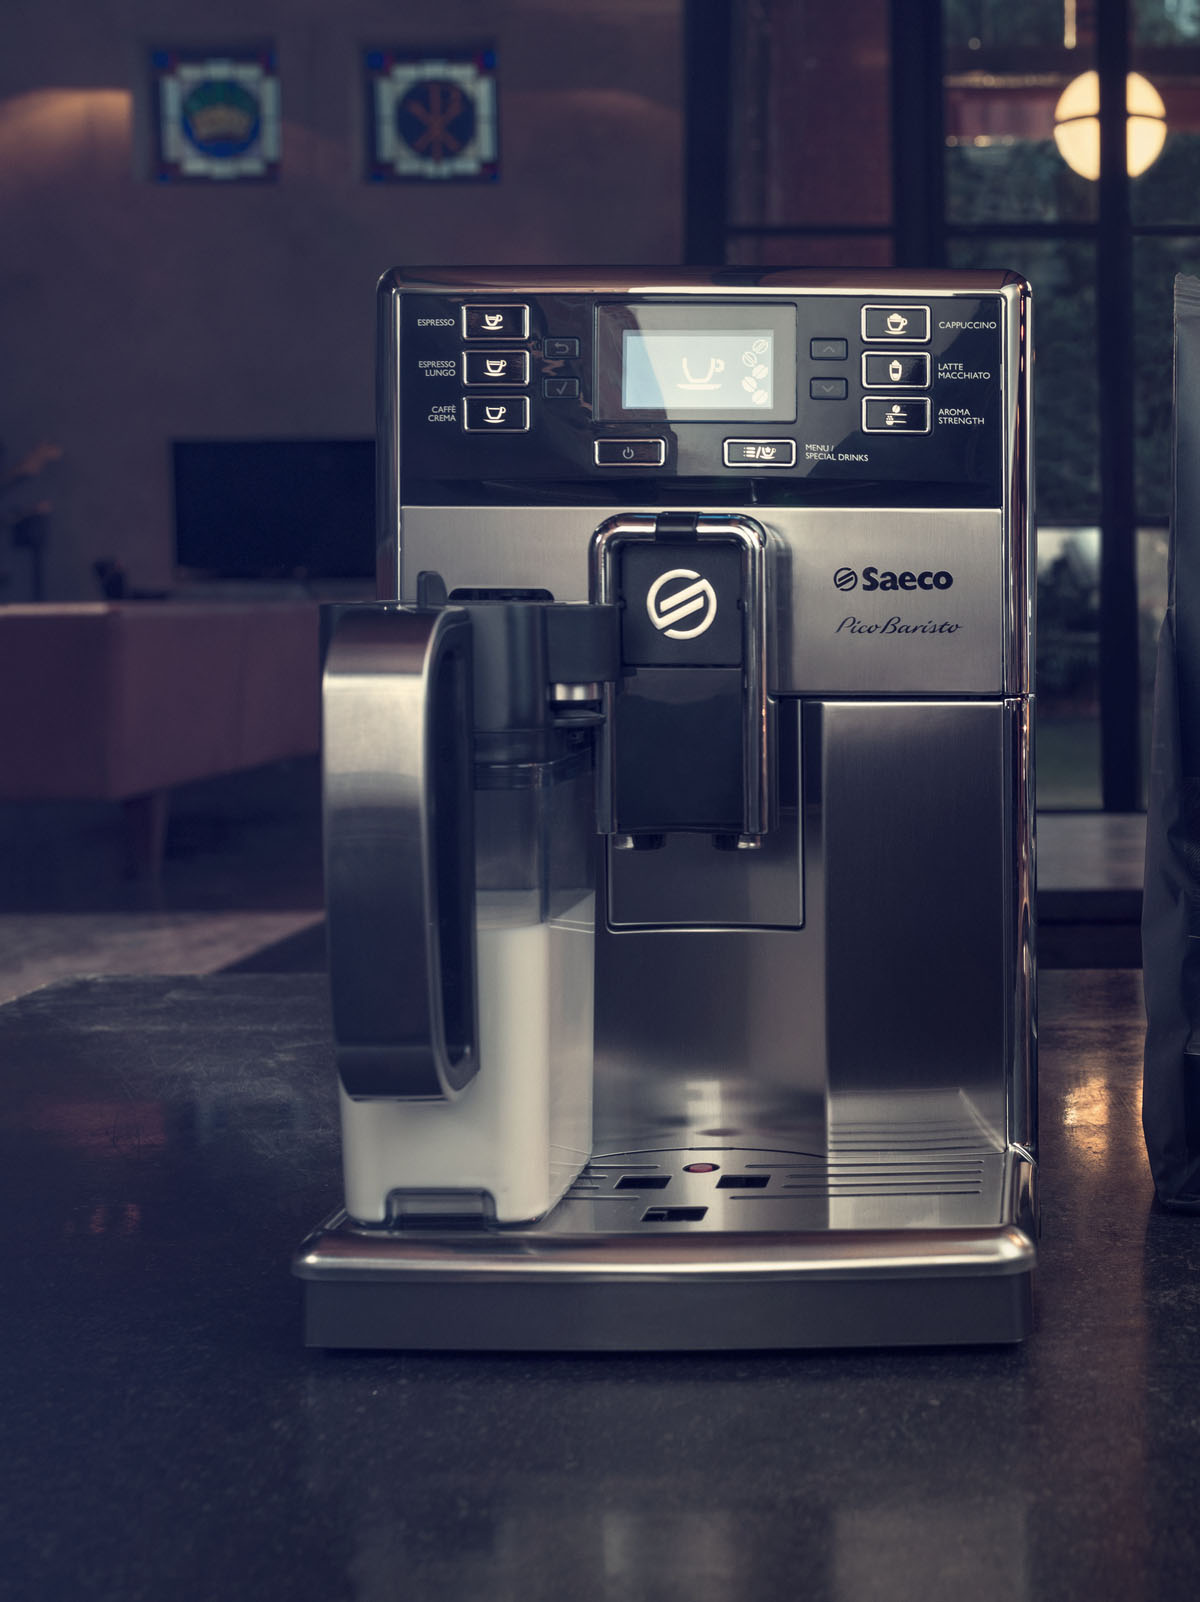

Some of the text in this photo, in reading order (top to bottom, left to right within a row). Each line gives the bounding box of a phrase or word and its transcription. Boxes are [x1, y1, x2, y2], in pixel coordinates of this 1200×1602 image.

[417, 318, 455, 327] ESPRESSO
[938, 321, 997, 330] CAPPUCCINO
[418, 360, 456, 368] ESPRESSO
[938, 363, 964, 371] LATTE
[425, 369, 456, 377] LUNGO
[938, 372, 991, 380] MACCHIATO
[431, 404, 456, 413] CAFFÈ
[938, 408, 970, 416] AROMA
[428, 414, 456, 422] CREMA
[938, 417, 985, 425] STRENGTH
[805, 443, 829, 452] MENU
[805, 452, 869, 462] SPECIAL DRINKS
[862, 566, 953, 592] Saeco
